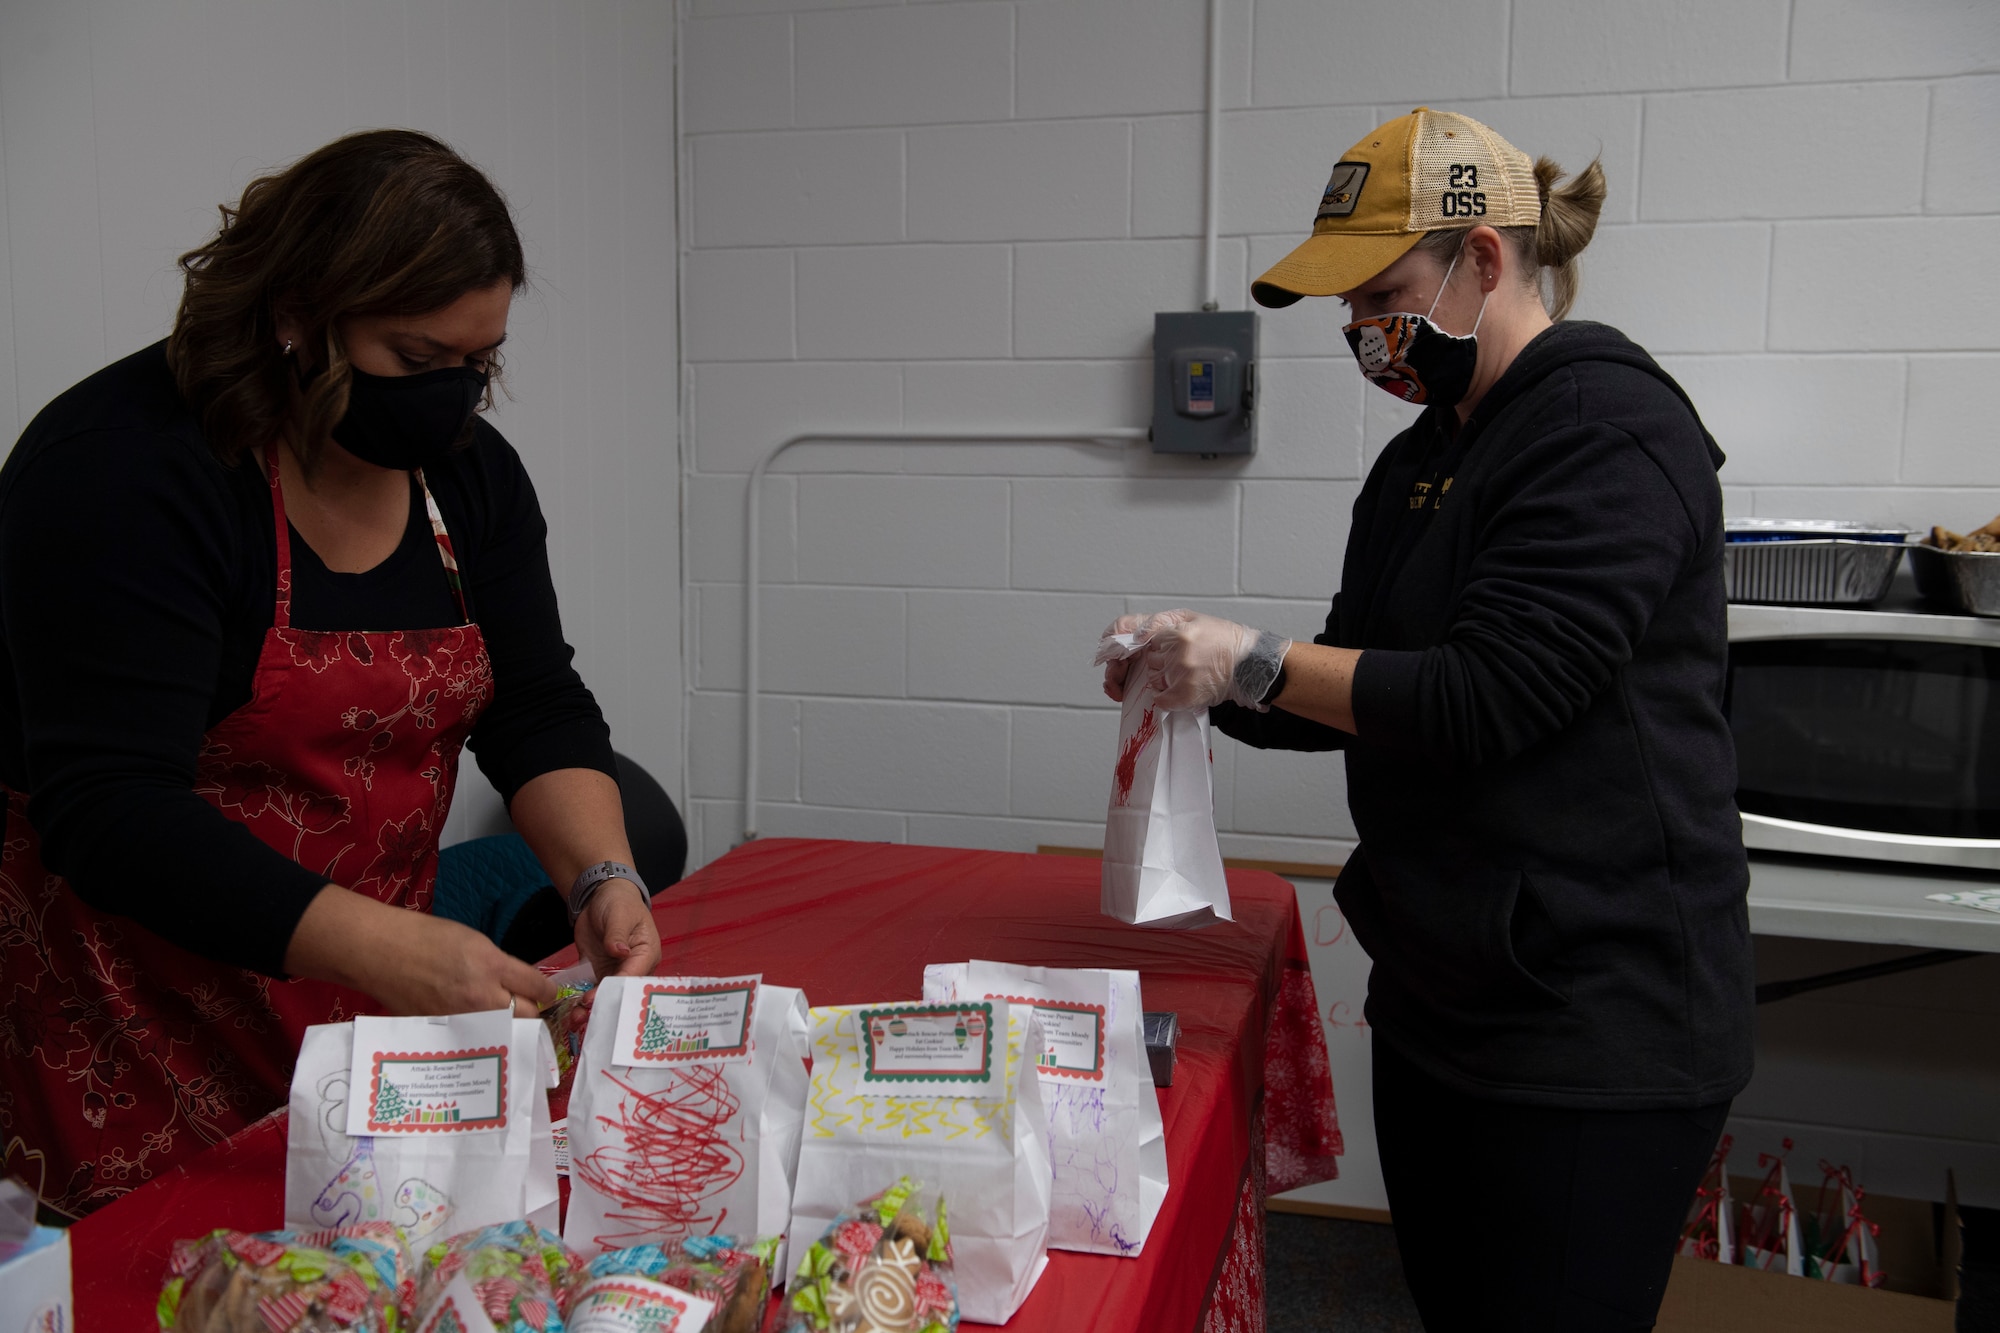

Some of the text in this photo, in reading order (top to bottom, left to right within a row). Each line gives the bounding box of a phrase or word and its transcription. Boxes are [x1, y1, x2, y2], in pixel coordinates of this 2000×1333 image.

[1450, 165, 1477, 188] 23
[1442, 192, 1486, 217] OSS
[436, 1073, 462, 1081] Cookies!
[411, 1082, 439, 1090] Holidays
[472, 1079, 492, 1087] Moody
[409, 1091, 448, 1099] surrounding
[448, 1089, 485, 1097] communities
